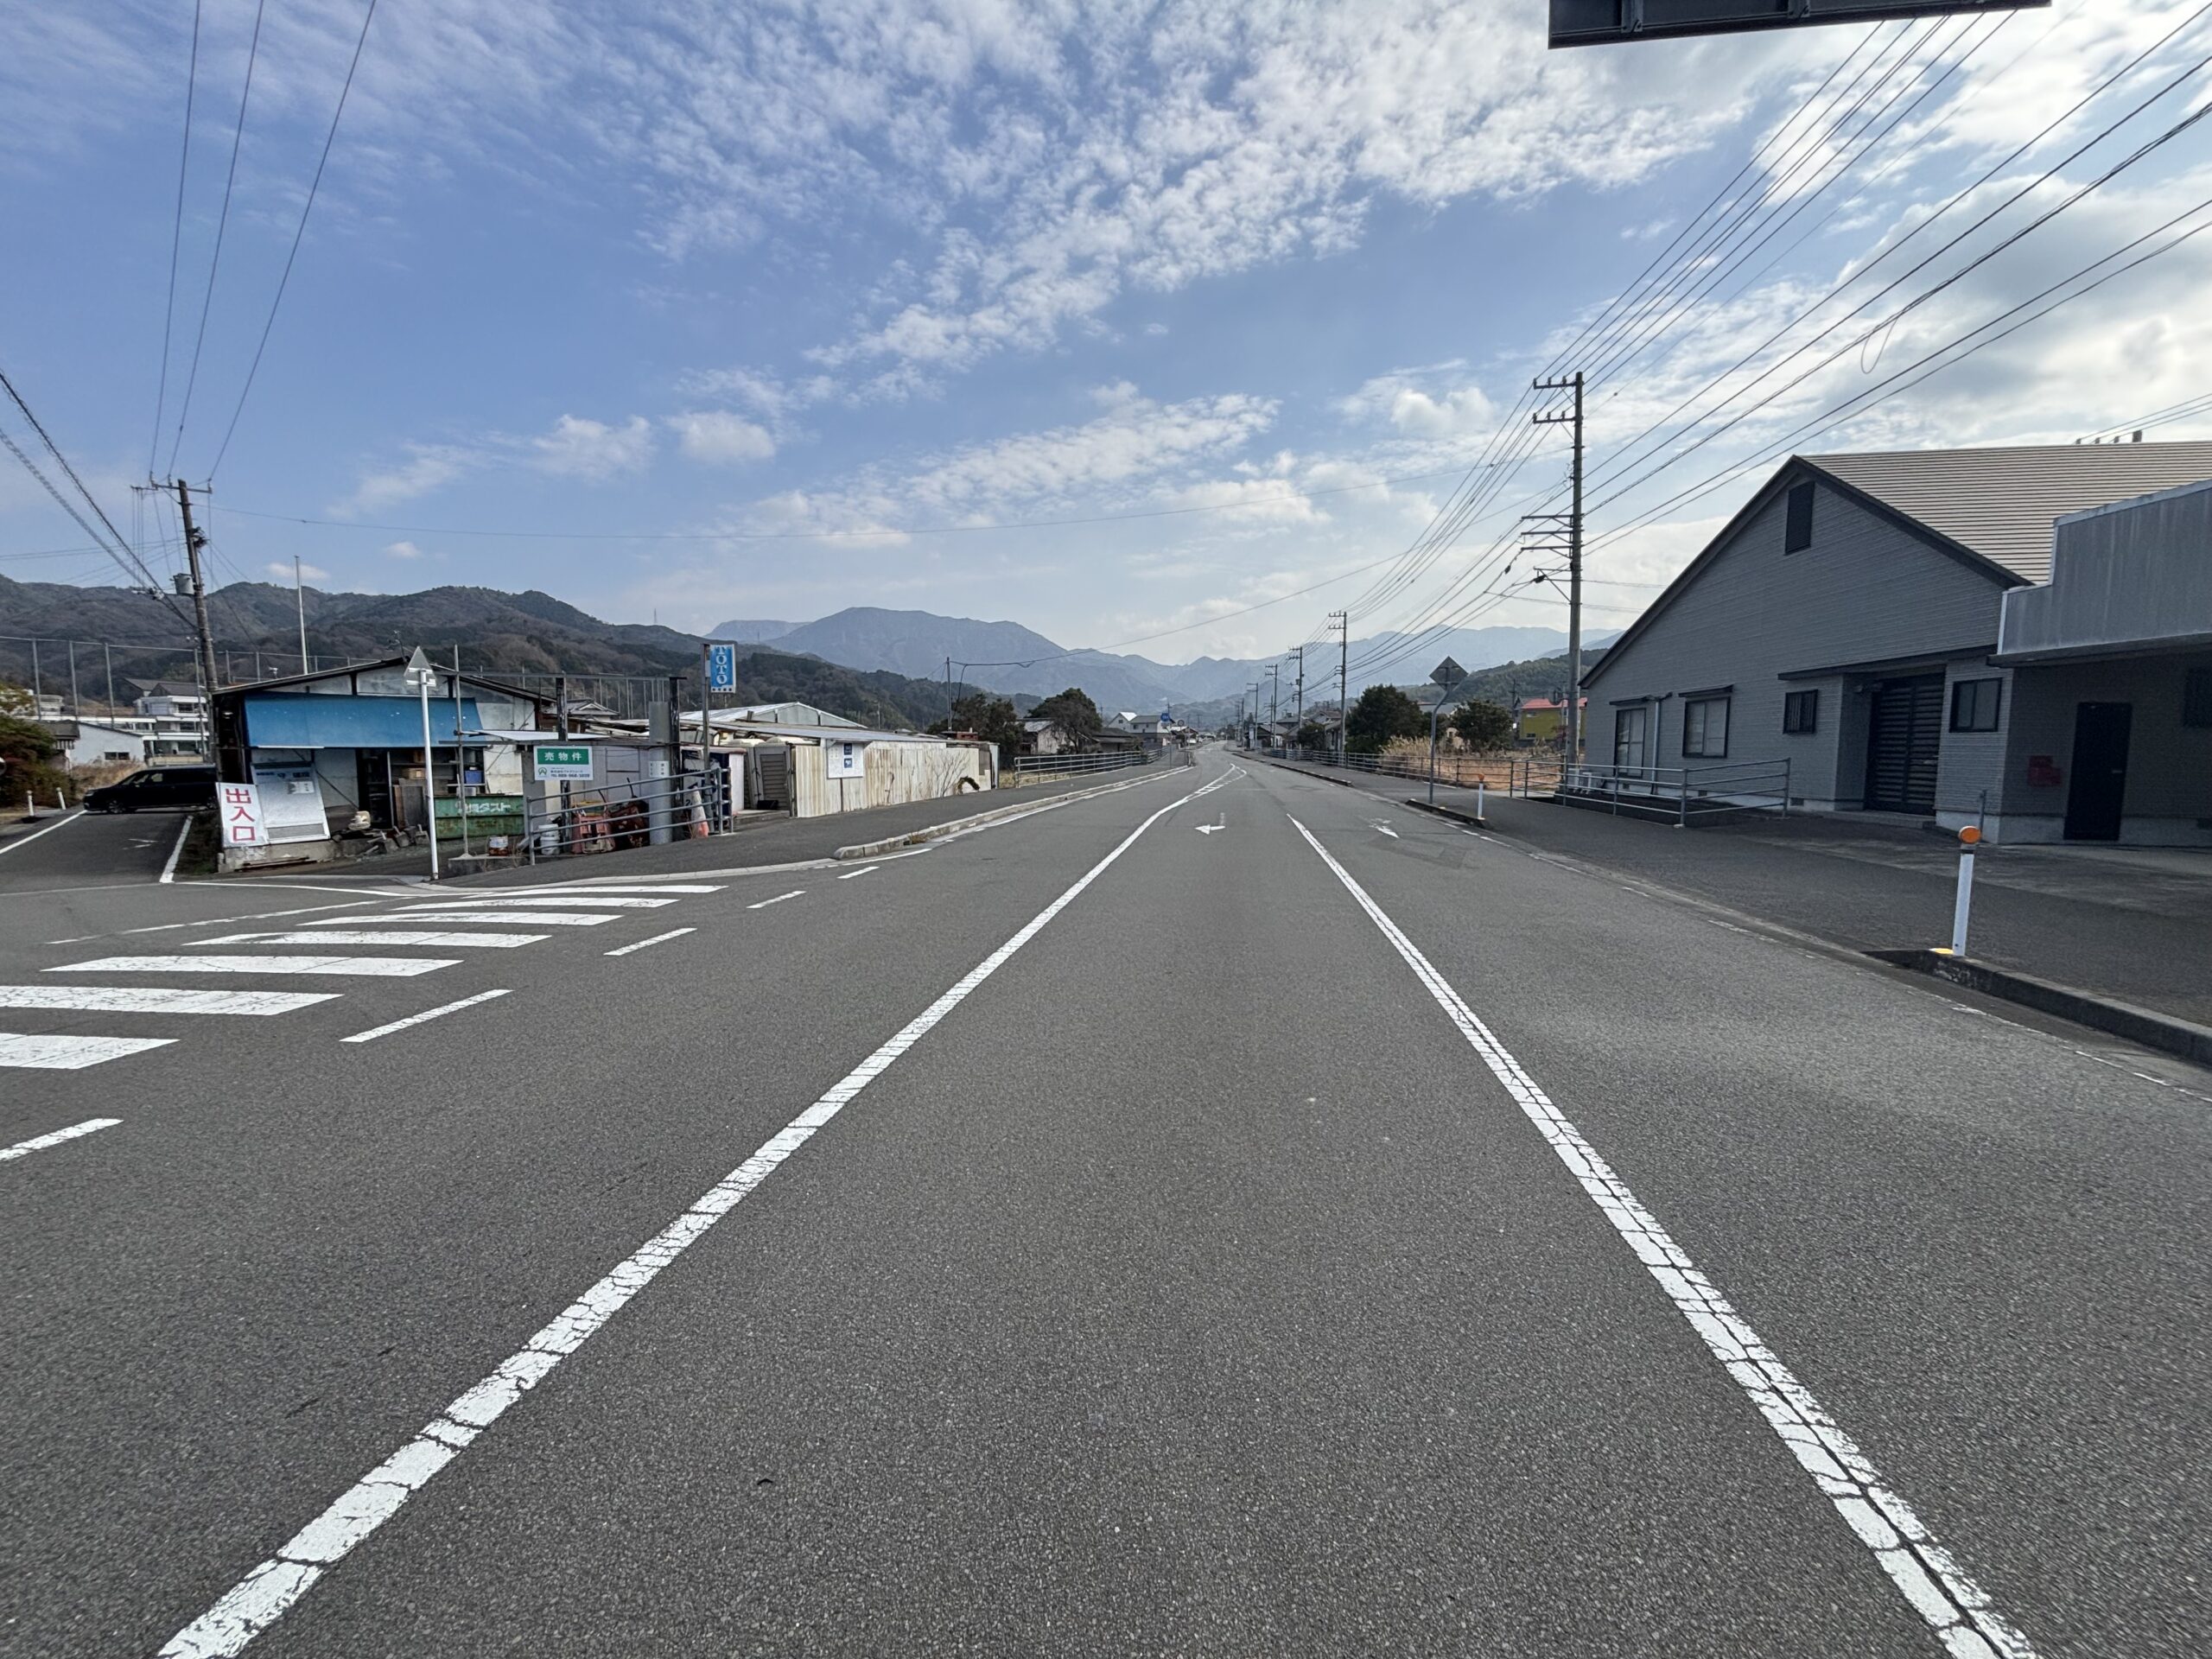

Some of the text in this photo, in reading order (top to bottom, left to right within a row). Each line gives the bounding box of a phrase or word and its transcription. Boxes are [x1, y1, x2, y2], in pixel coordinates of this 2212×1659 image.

[715, 645, 728, 684] TOTO
[544, 752, 582, 761] 売物件
[226, 787, 256, 842] 出入口
